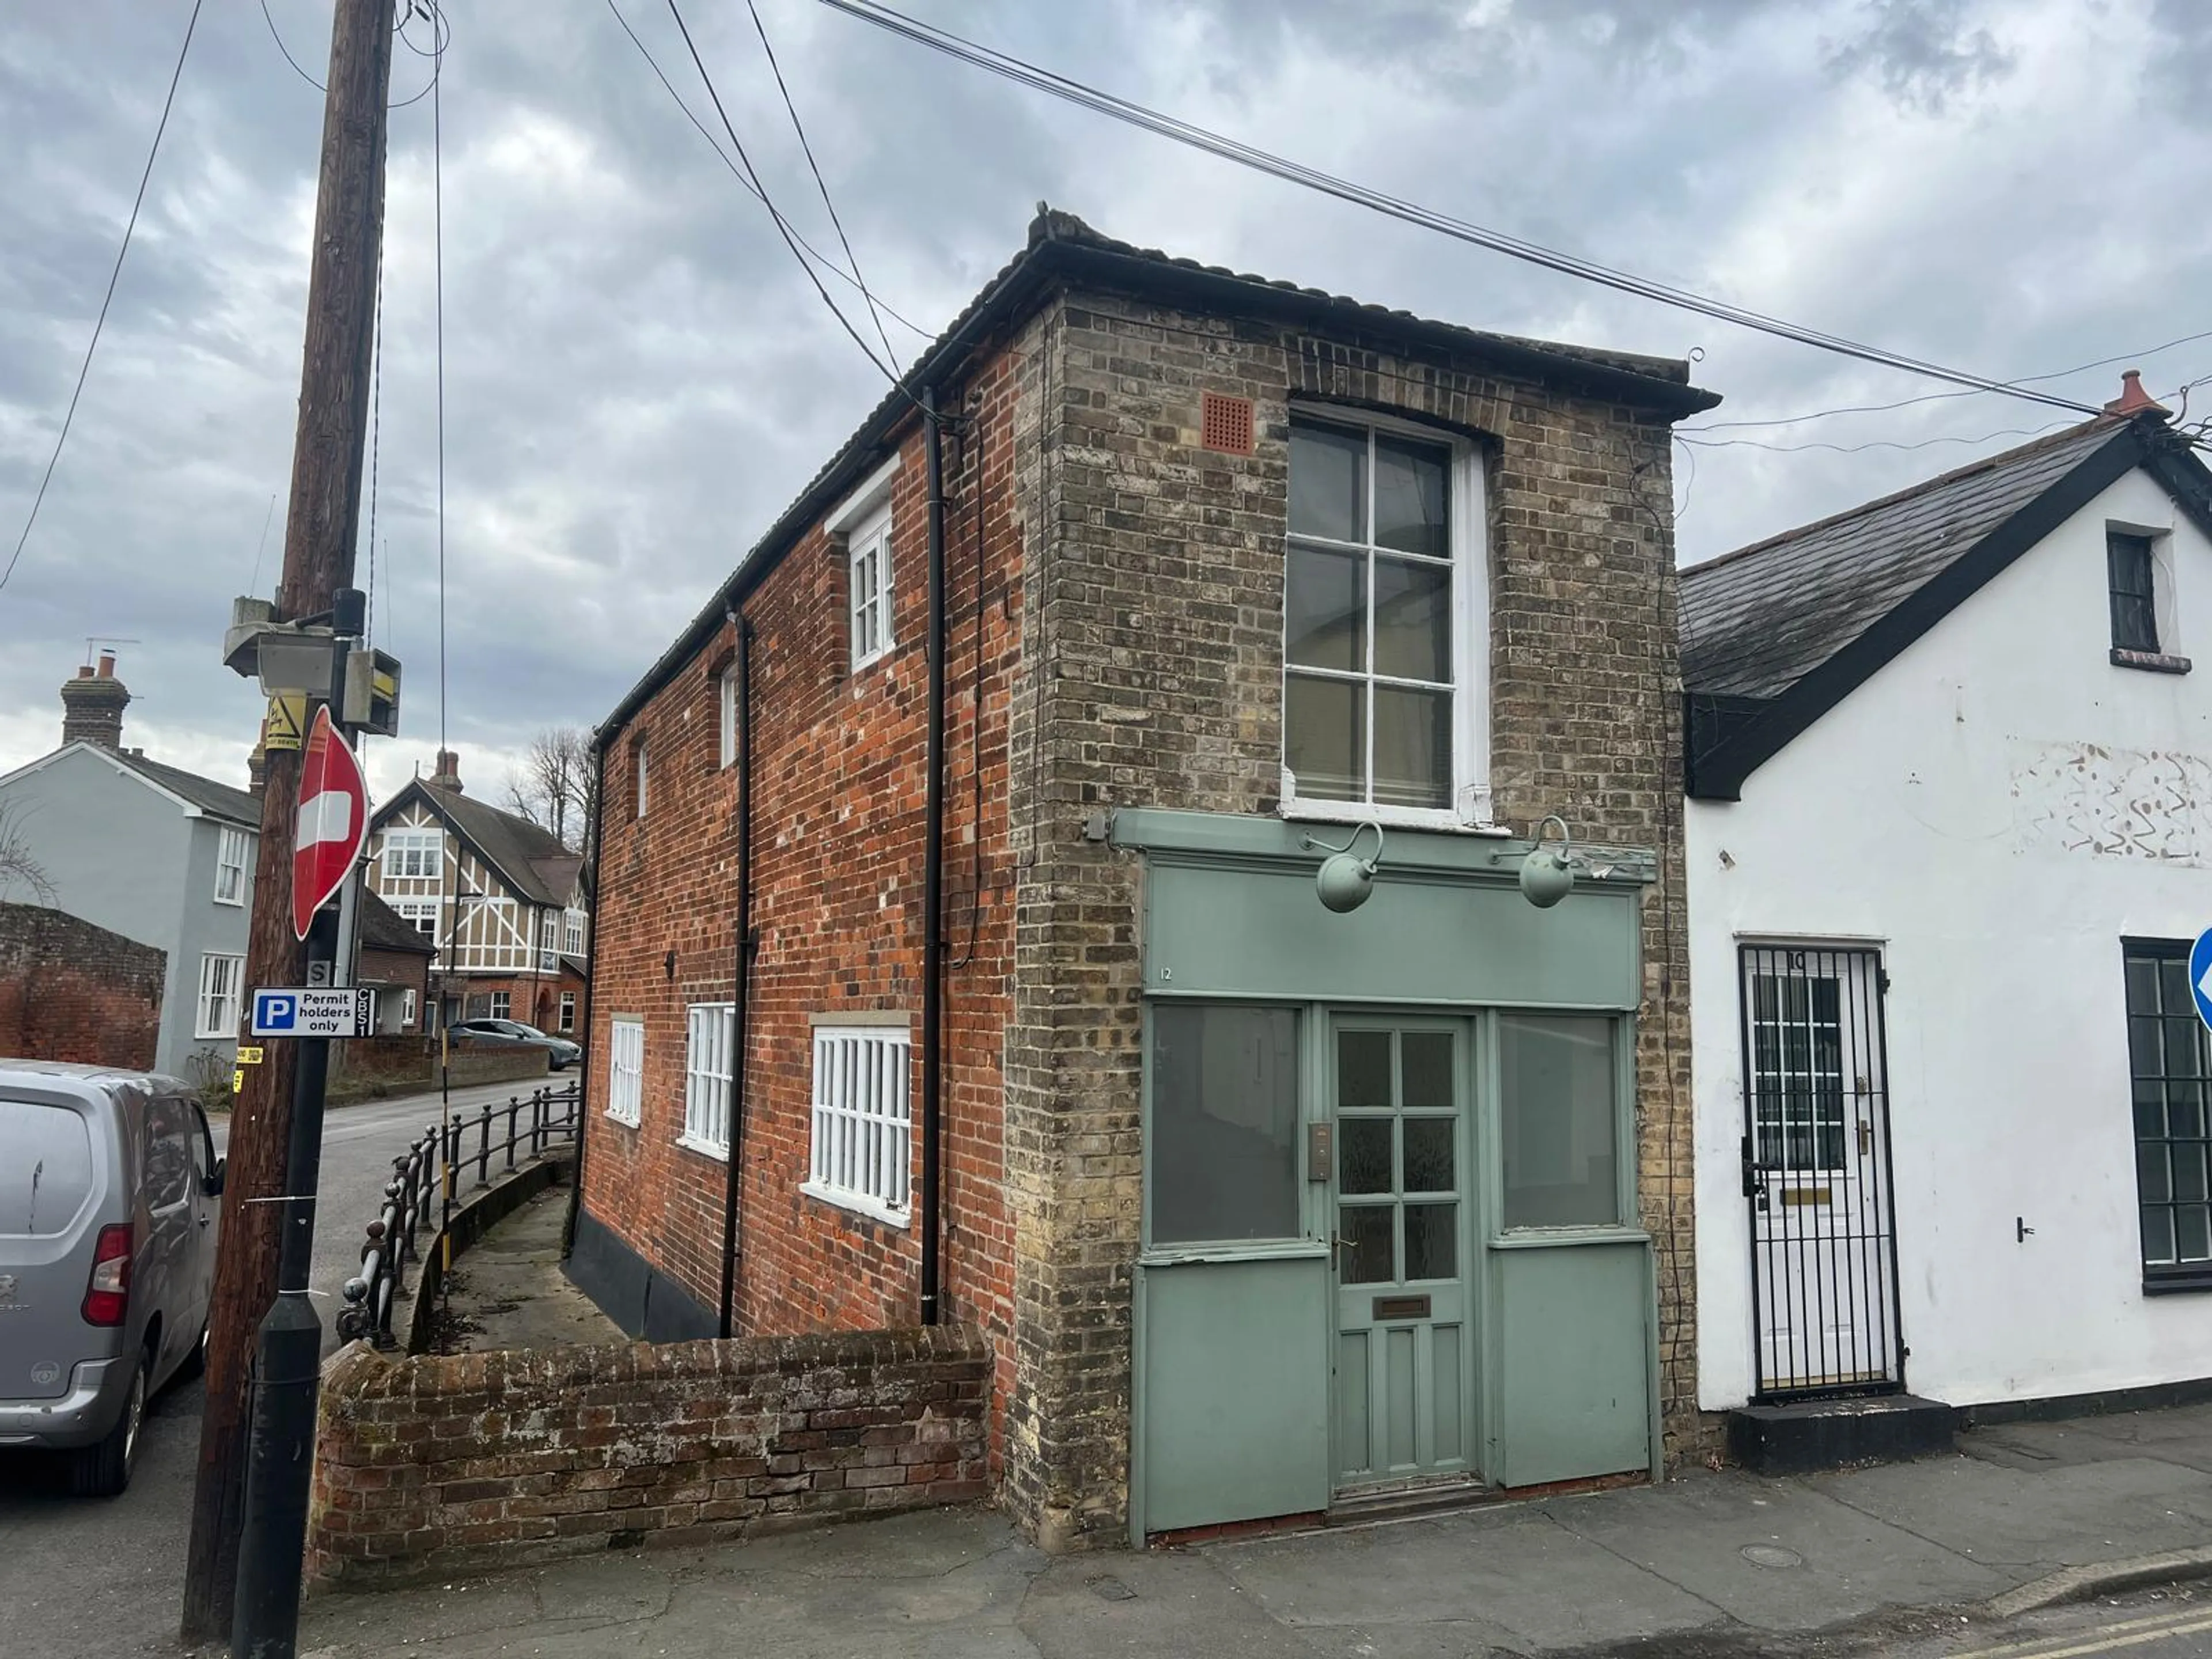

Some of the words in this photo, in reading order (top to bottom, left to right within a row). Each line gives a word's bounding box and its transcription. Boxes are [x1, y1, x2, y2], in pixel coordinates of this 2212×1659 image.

[1790, 952, 1805, 969] 10
[1161, 968, 1171, 980] 12
[304, 994, 349, 1005] Permit
[267, 999, 290, 1026] P
[300, 1007, 350, 1017] holders
[310, 1021, 339, 1032] only
